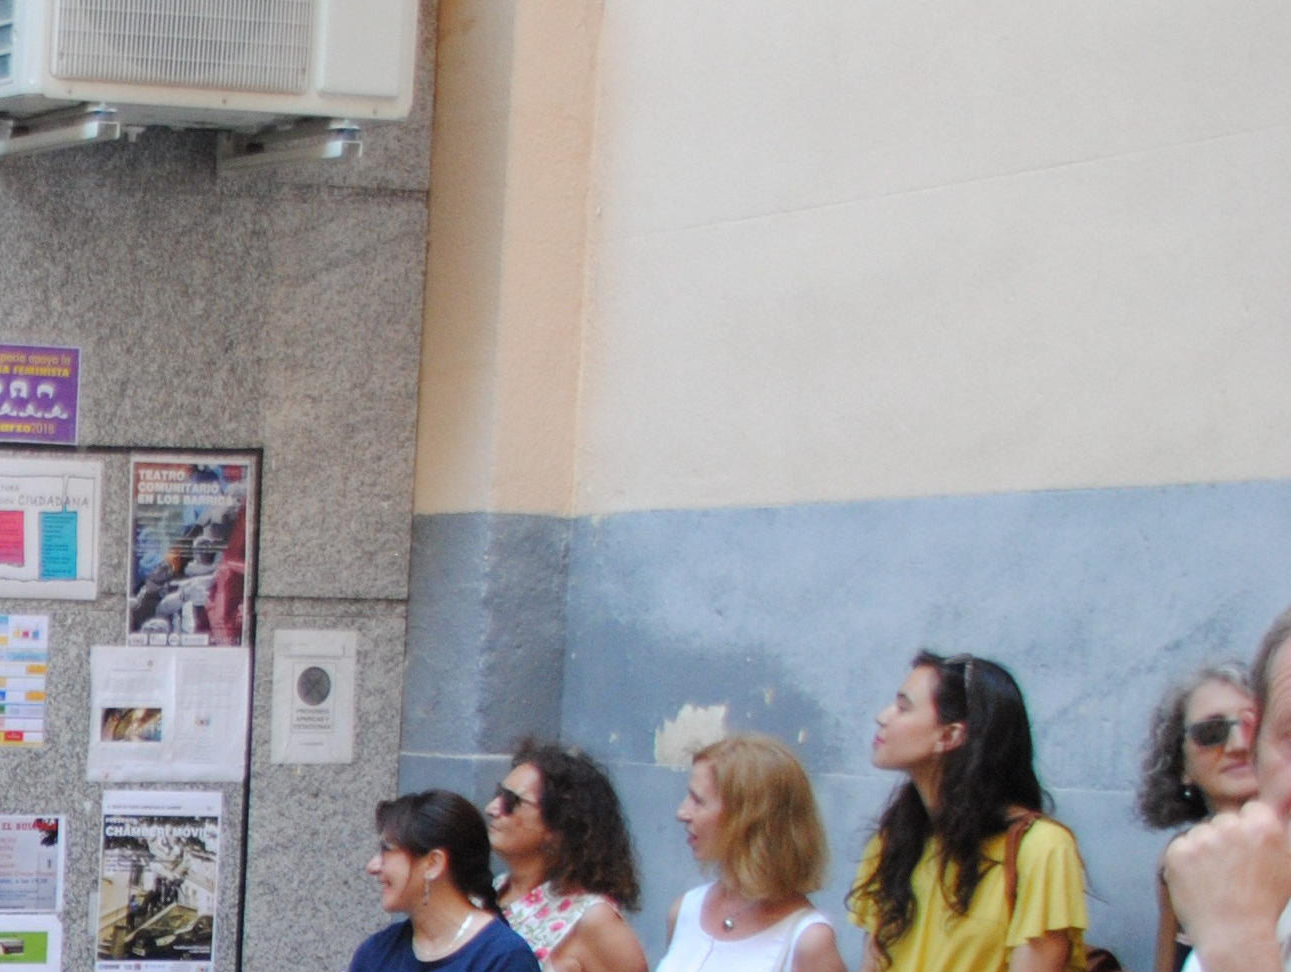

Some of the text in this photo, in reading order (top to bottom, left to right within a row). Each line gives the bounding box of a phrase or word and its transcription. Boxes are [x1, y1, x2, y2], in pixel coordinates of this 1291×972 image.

[13, 364, 71, 378] FEMINISTA
[138, 469, 186, 482] TEATRO
[137, 481, 219, 495] COMUNITARIO
[137, 493, 155, 505] EN
[157, 494, 181, 506] LOS
